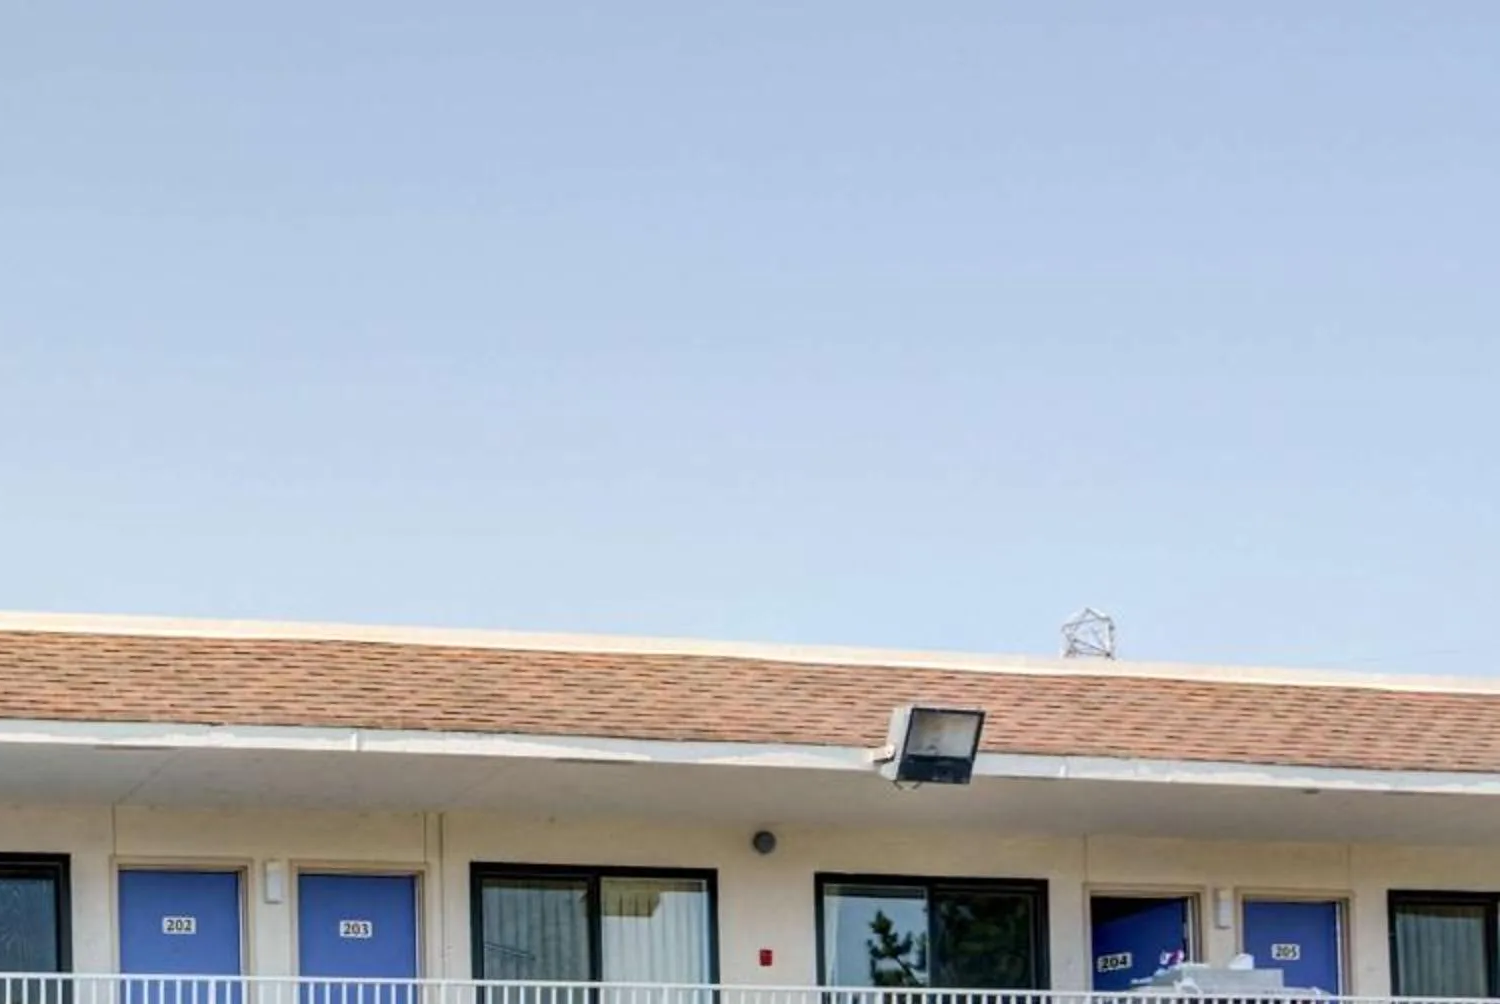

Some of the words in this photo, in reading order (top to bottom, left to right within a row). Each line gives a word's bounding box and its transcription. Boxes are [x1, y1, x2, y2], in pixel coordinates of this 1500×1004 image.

[167, 919, 192, 931] 202
[343, 922, 369, 935] 203
[1101, 955, 1128, 969] 204
